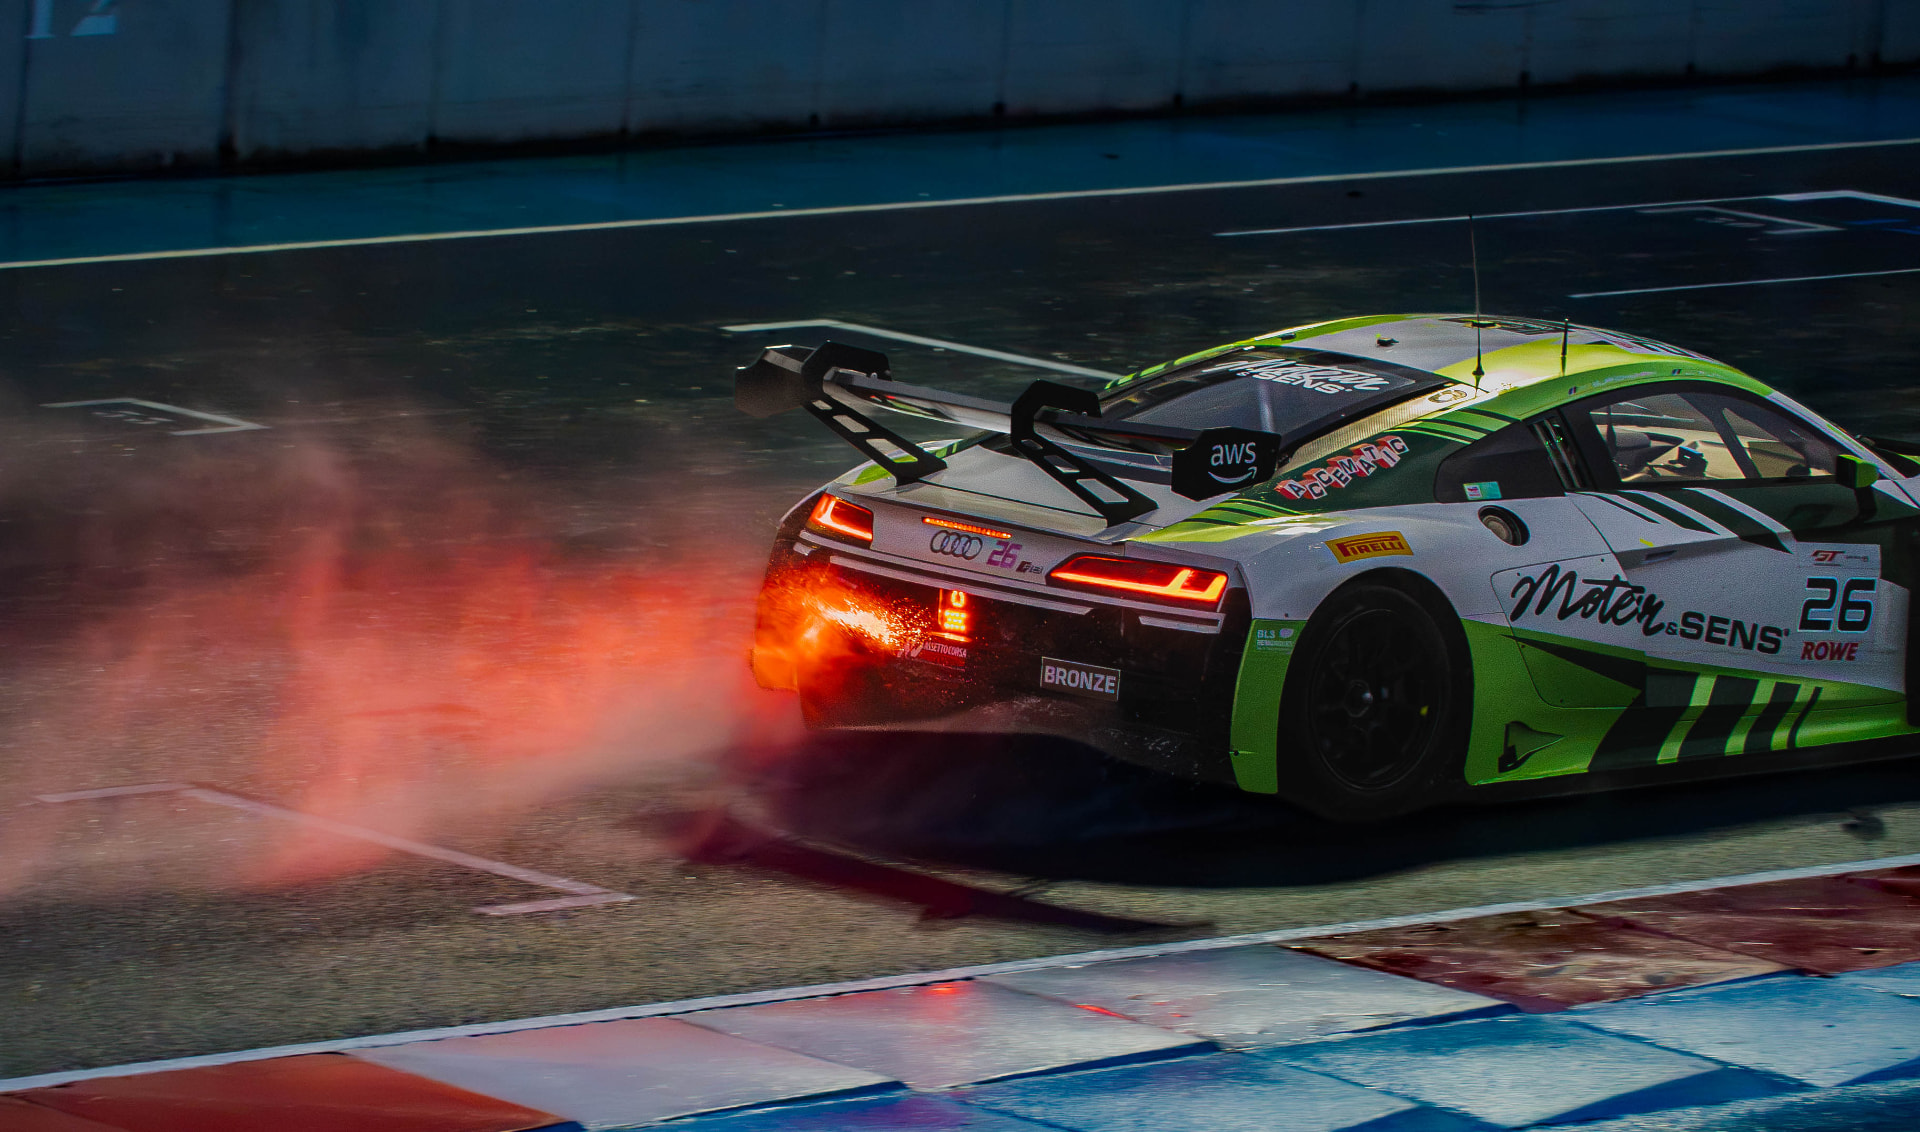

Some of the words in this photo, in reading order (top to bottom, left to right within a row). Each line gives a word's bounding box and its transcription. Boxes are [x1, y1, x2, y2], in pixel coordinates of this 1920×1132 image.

[1210, 441, 1256, 467] aws
[1285, 435, 1409, 498] ACCEMATIC
[986, 541, 1023, 569] 26
[1336, 535, 1404, 558] PIRELLI
[1797, 576, 1877, 633] 26
[1679, 610, 1783, 655] SENS
[1801, 641, 1859, 661] ROWE
[1044, 665, 1116, 694] BRONZE
